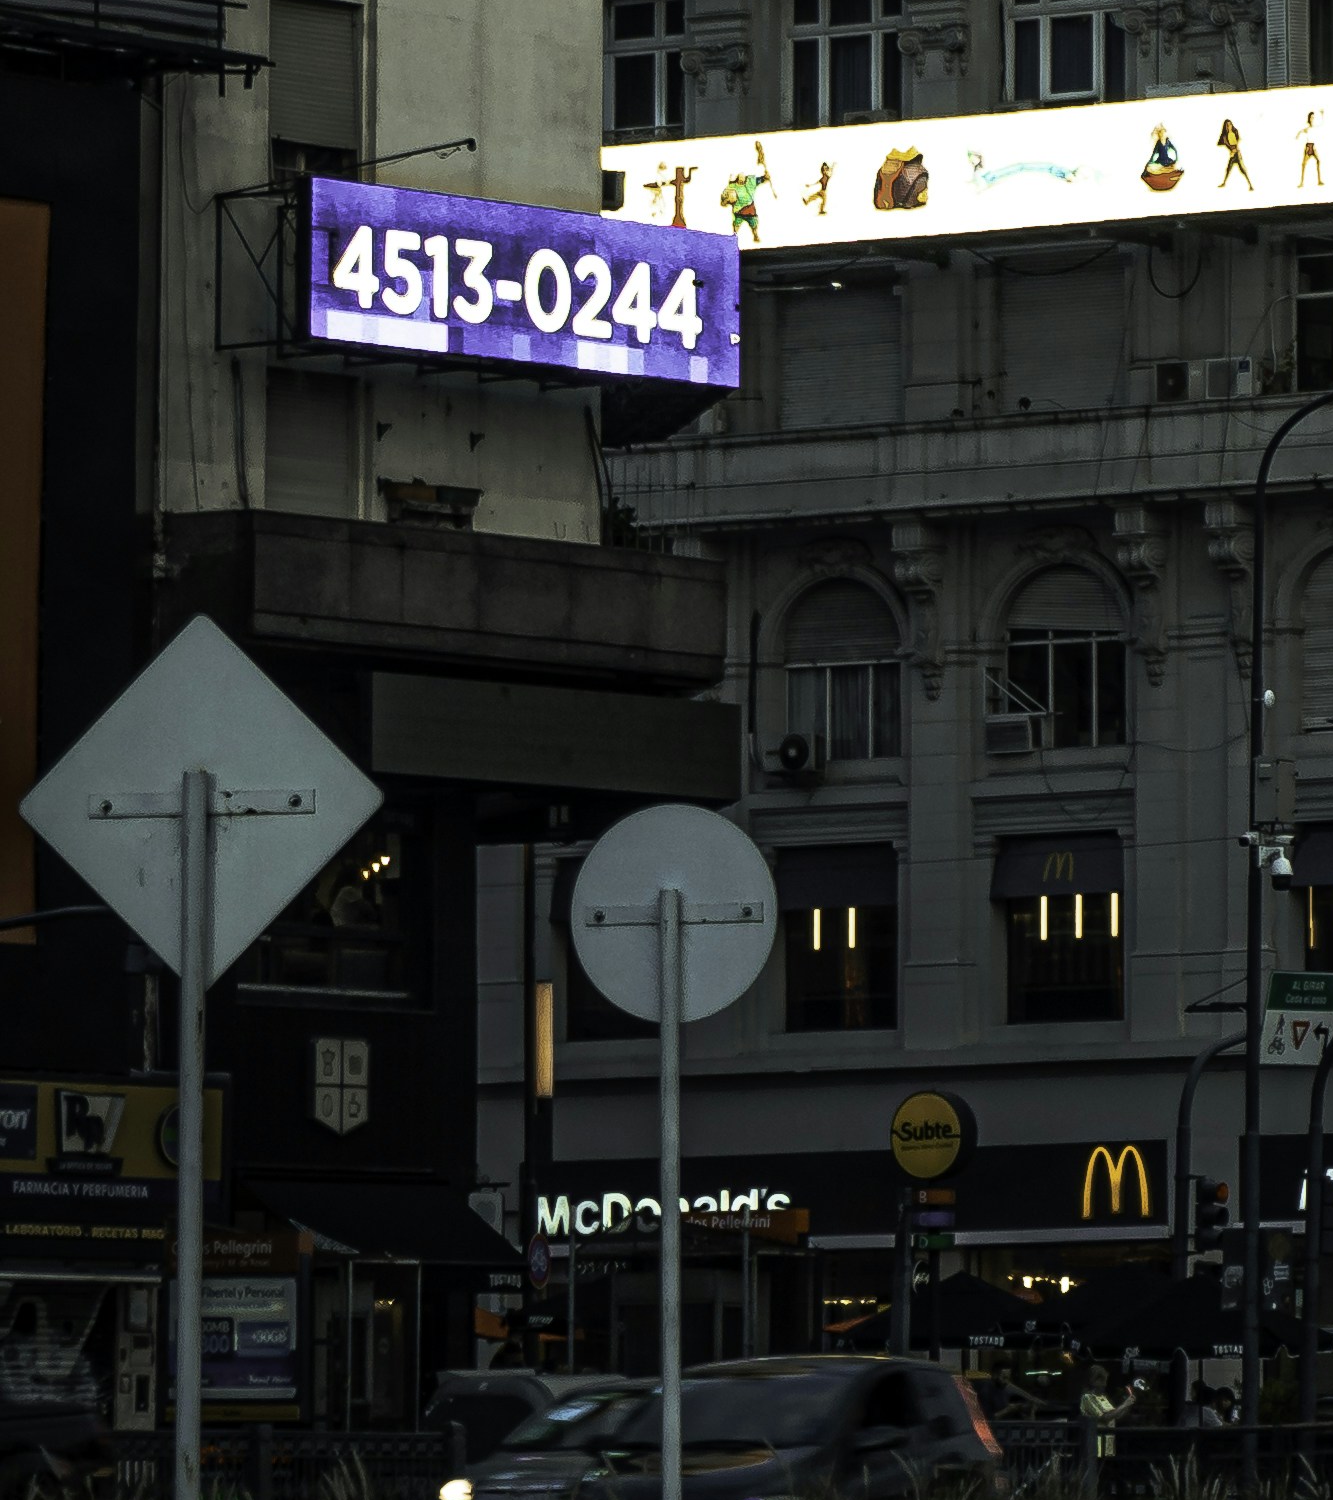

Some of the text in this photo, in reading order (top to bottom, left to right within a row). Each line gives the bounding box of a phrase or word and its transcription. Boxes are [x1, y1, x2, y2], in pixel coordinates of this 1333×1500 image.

[333, 225, 703, 350] 4513-0244
[901, 1121, 953, 1142] Subte
[12, 1179, 148, 1199] FARMACIA Y PERFUMERIA
[919, 1190, 928, 1204] B
[537, 1187, 791, 1236] McDoald's
[4, 1223, 82, 1237] LABORATORIO
[214, 1239, 272, 1258] Pellegrini
[968, 1335, 1005, 1350] TOSTADO
[1212, 1344, 1245, 1356] TOSTAD
